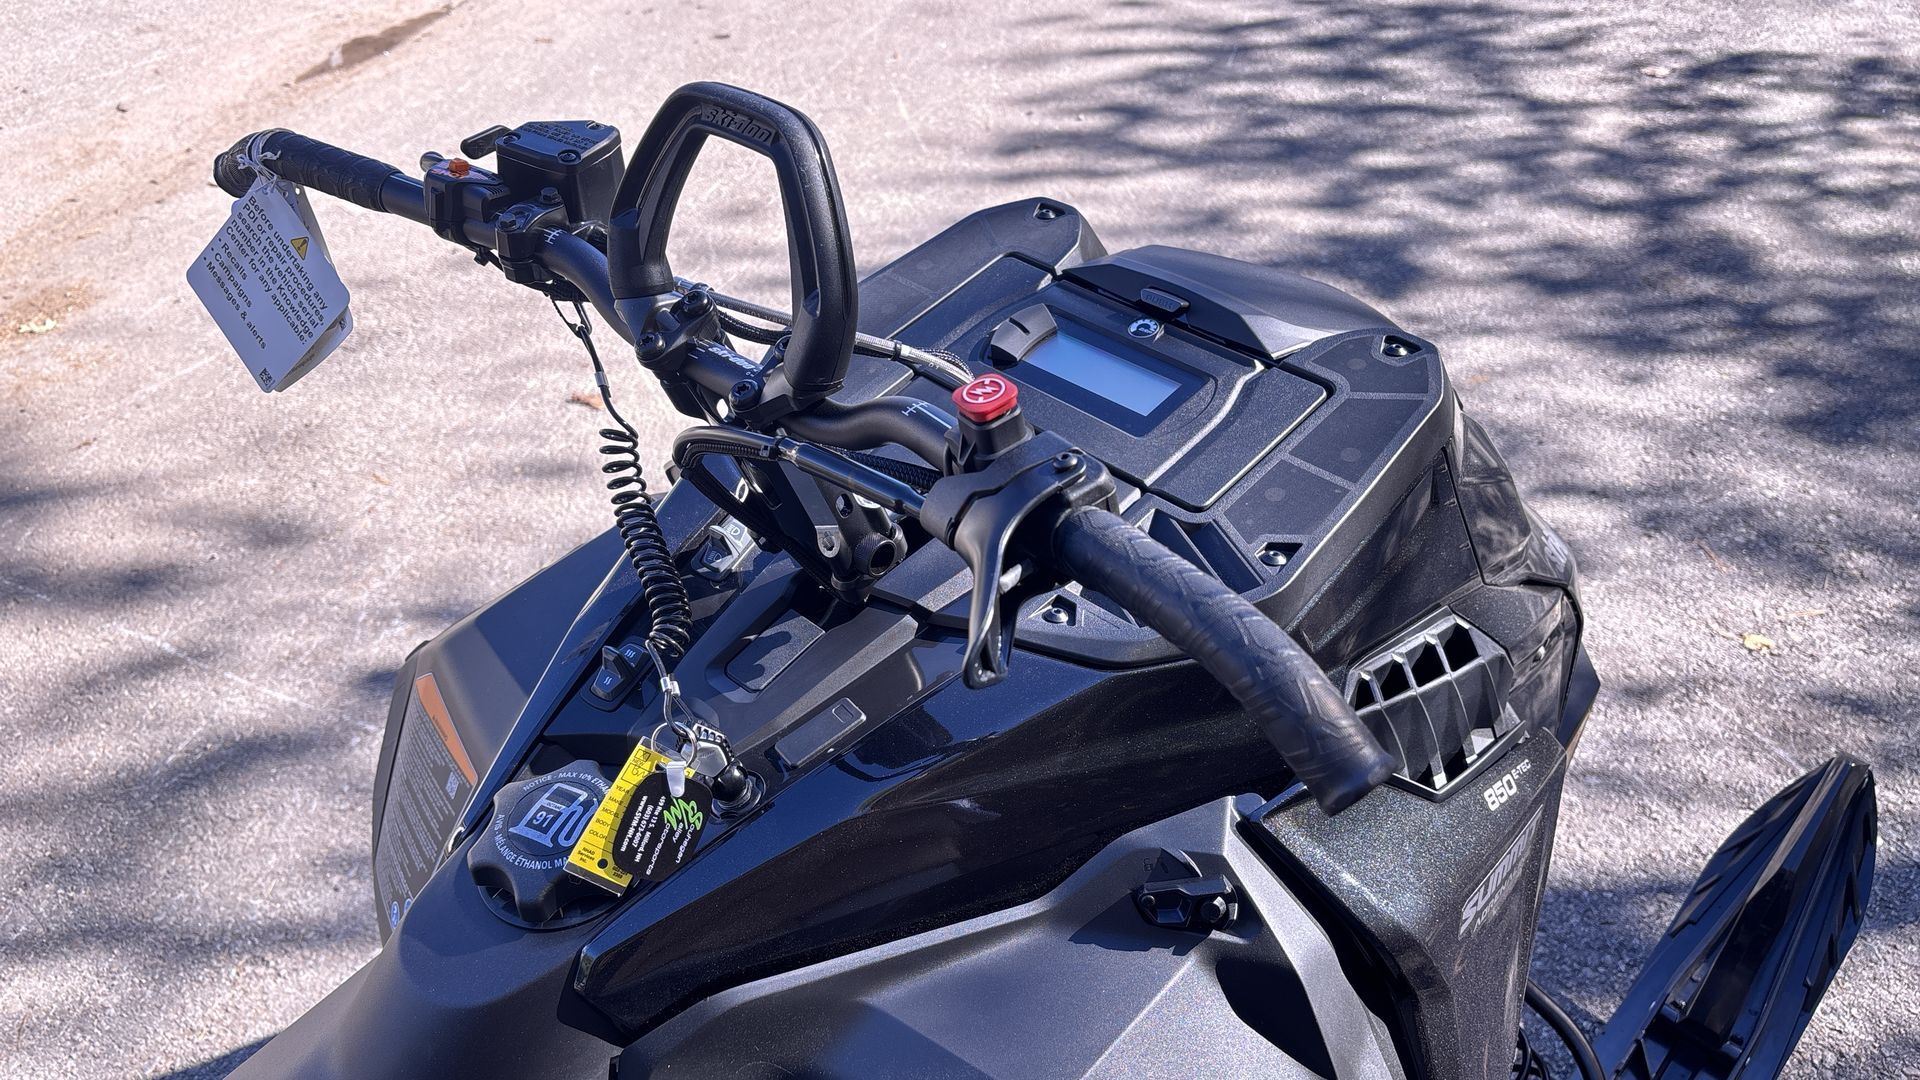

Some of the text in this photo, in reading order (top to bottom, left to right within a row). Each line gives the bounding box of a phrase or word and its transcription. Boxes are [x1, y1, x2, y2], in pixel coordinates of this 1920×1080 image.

[220, 242, 248, 281] Recalls
[242, 204, 326, 326] PDI or repair procedures,
[247, 195, 329, 310] Before undertaking any
[214, 252, 253, 309] Campaigns
[225, 226, 250, 258] Center
[248, 257, 261, 275] for
[258, 274, 273, 294] any
[271, 293, 308, 346] applicable:
[231, 219, 259, 257] number
[257, 257, 266, 269] in
[264, 268, 278, 286] the
[276, 286, 314, 339] Knowledge
[236, 212, 262, 245] search
[261, 245, 274, 264] the
[273, 263, 299, 299] vehicle
[297, 299, 319, 328] serial
[206, 262, 267, 350] Messages & alerts
[522, 774, 553, 792] NOTICE
[578, 772, 592, 782] 10%
[1484, 758, 1532, 812] 850 E-TEC
[494, 813, 503, 832] AVIS
[532, 810, 555, 828] 91
[595, 818, 610, 828] BODY
[602, 807, 620, 818] MODEL
[642, 804, 654, 819] (603)
[494, 834, 519, 863] MÉLANGE
[554, 855, 570, 868] MA
[634, 852, 643, 863] NH
